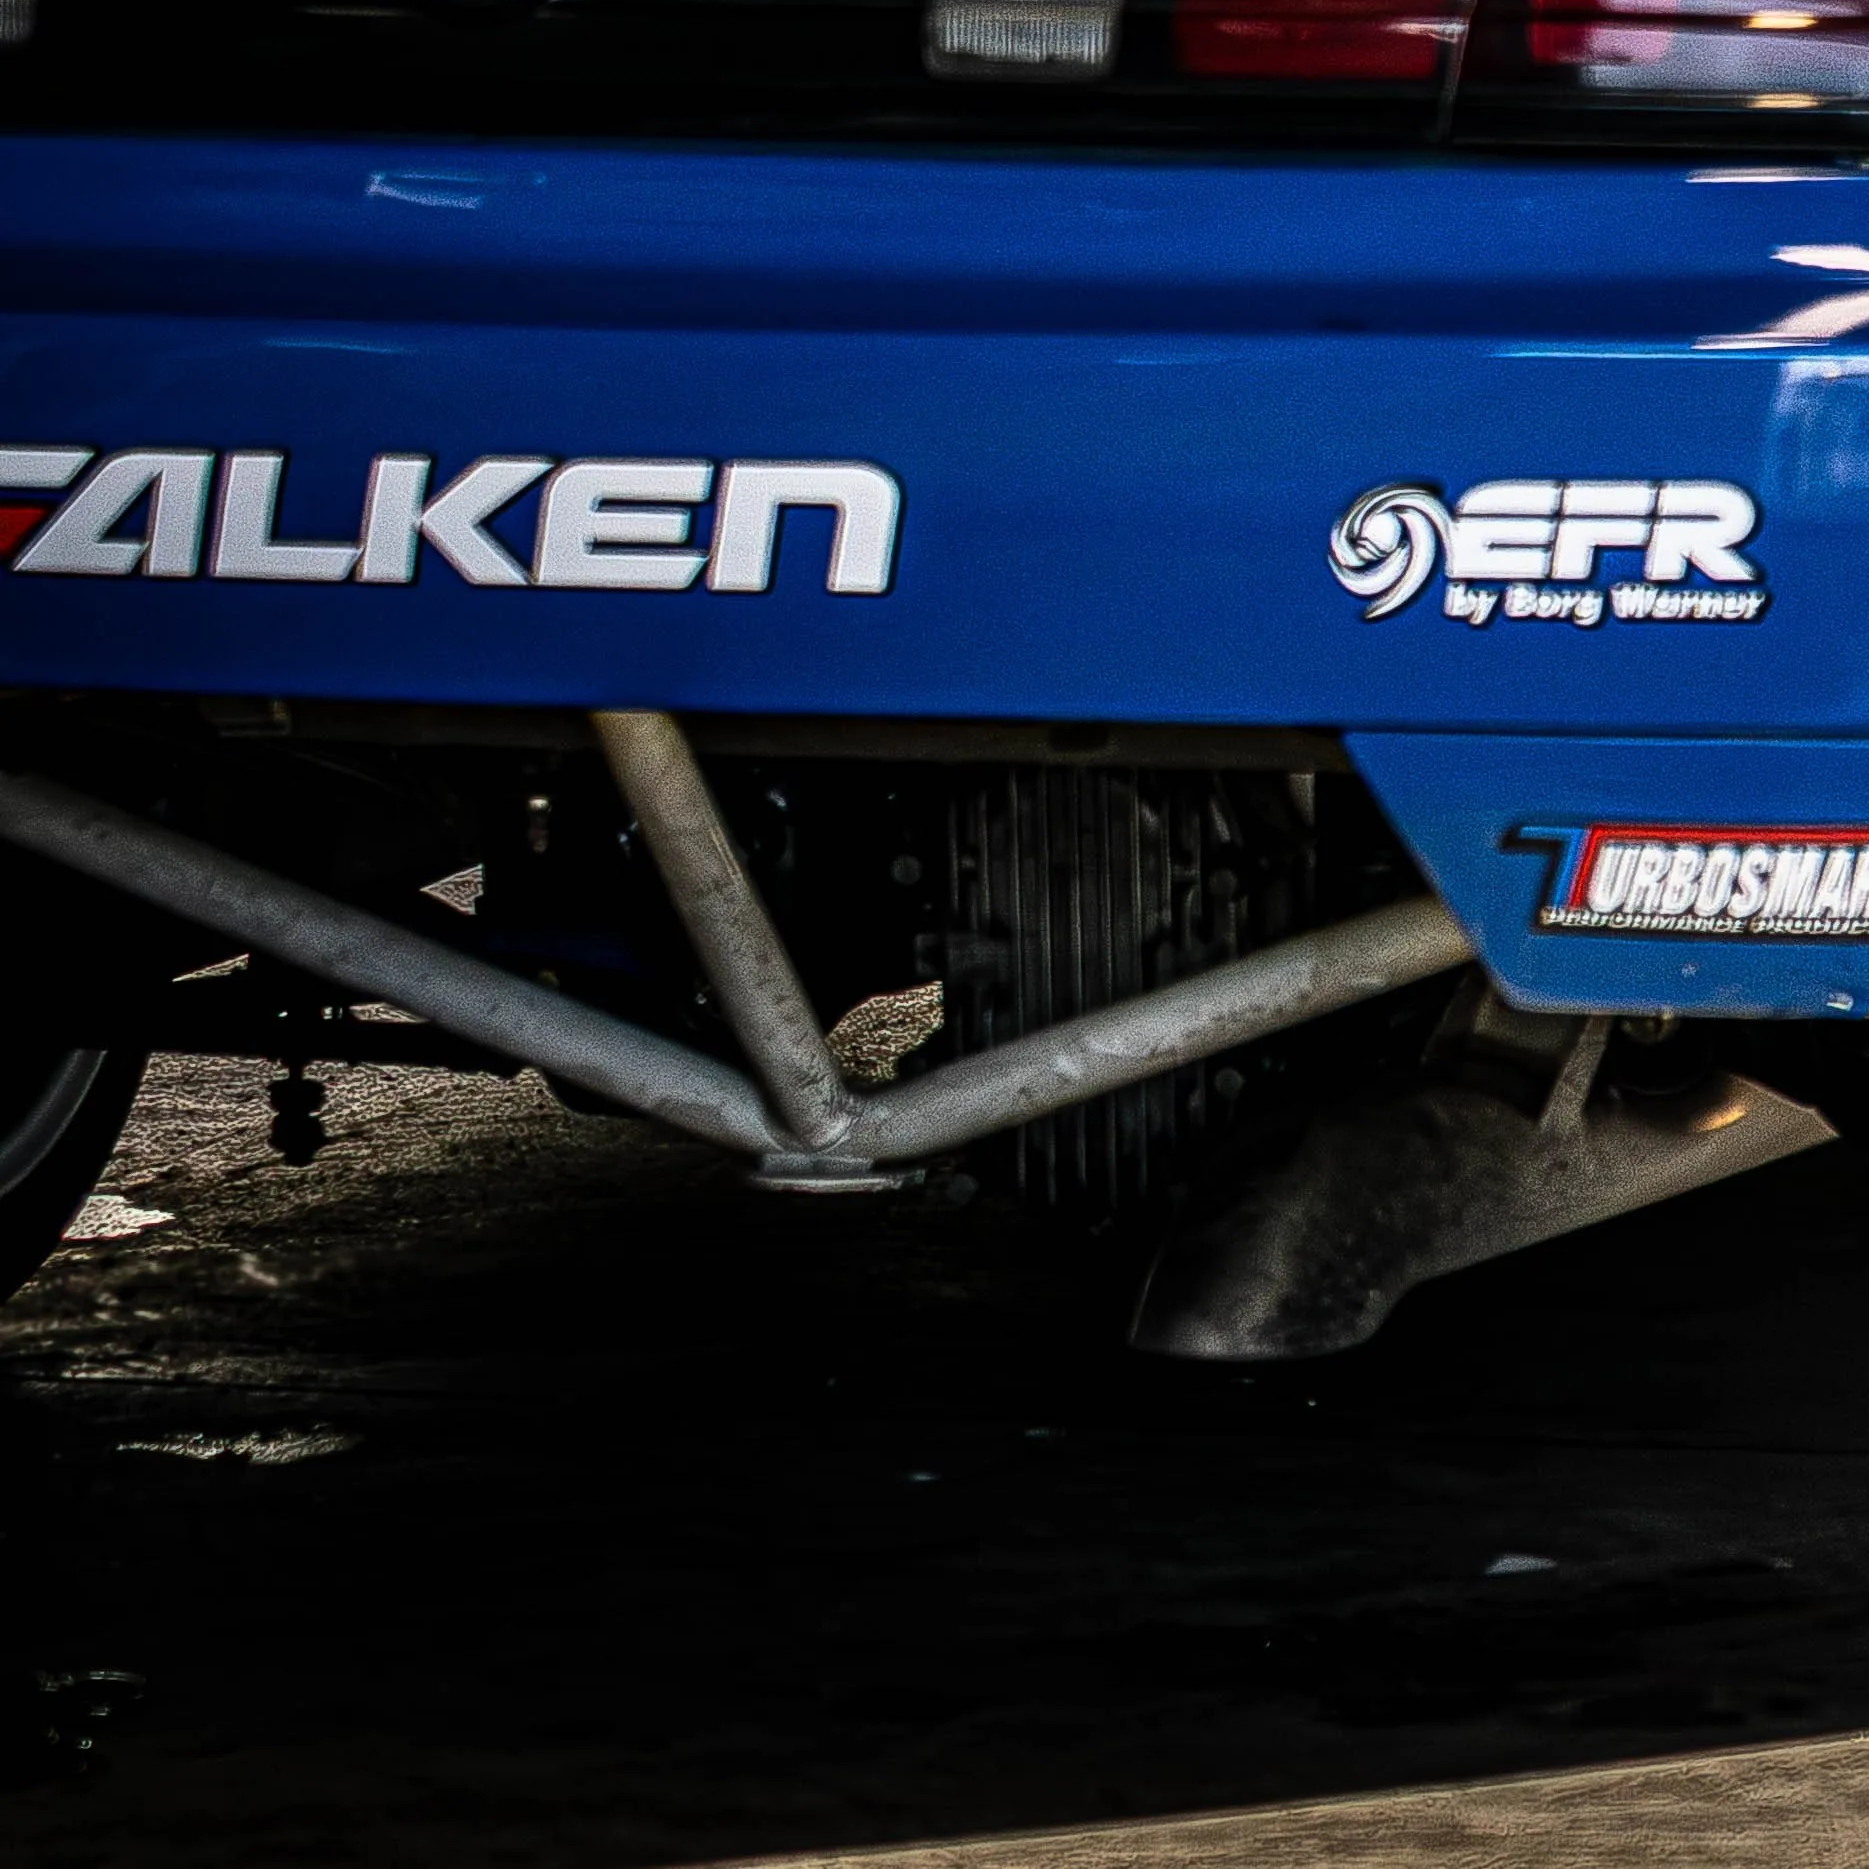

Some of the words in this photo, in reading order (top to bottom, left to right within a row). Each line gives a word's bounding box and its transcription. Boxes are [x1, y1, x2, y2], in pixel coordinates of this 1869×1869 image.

[1446, 479, 1757, 581] EFR
[1443, 581, 1499, 626] by
[1504, 581, 1603, 626] Borg
